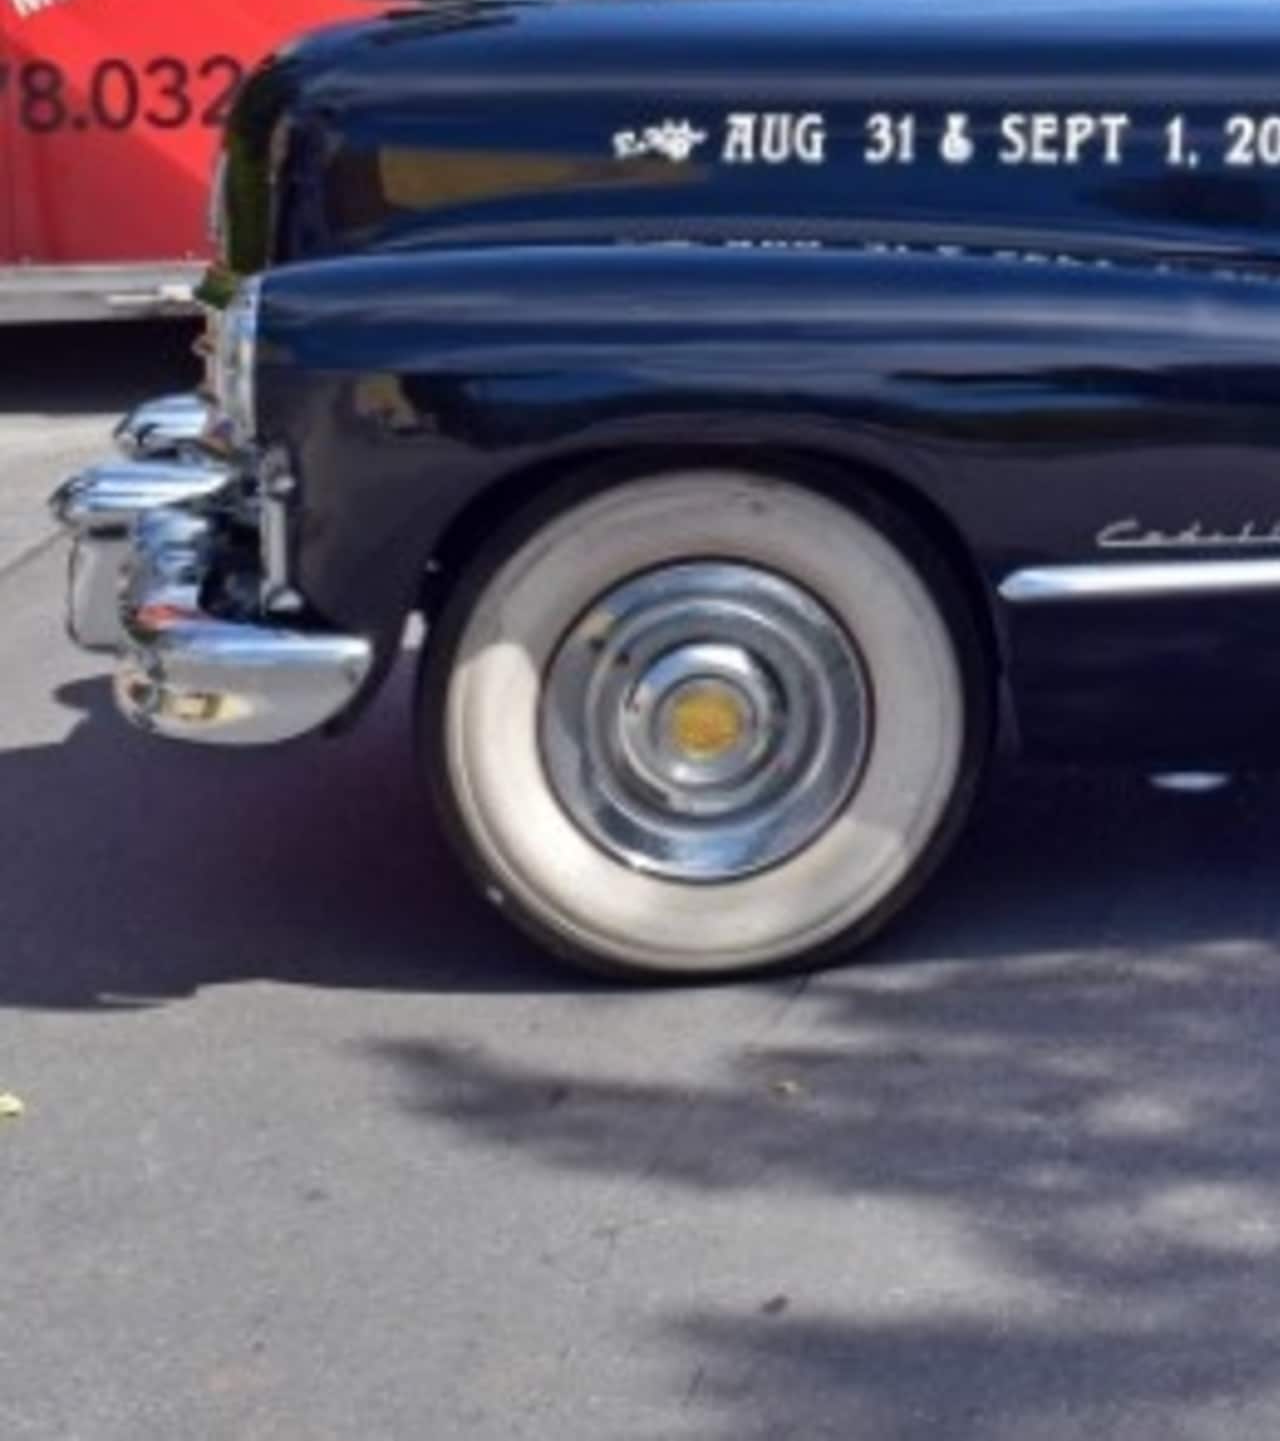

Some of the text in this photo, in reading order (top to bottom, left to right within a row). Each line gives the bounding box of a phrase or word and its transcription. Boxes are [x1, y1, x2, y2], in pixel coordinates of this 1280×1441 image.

[0, 53, 276, 133] 8.032
[722, 112, 826, 163] AUG
[863, 112, 915, 163] 31
[939, 112, 975, 162] &
[1000, 112, 1129, 165] SEPT
[1165, 113, 1198, 168] 1,
